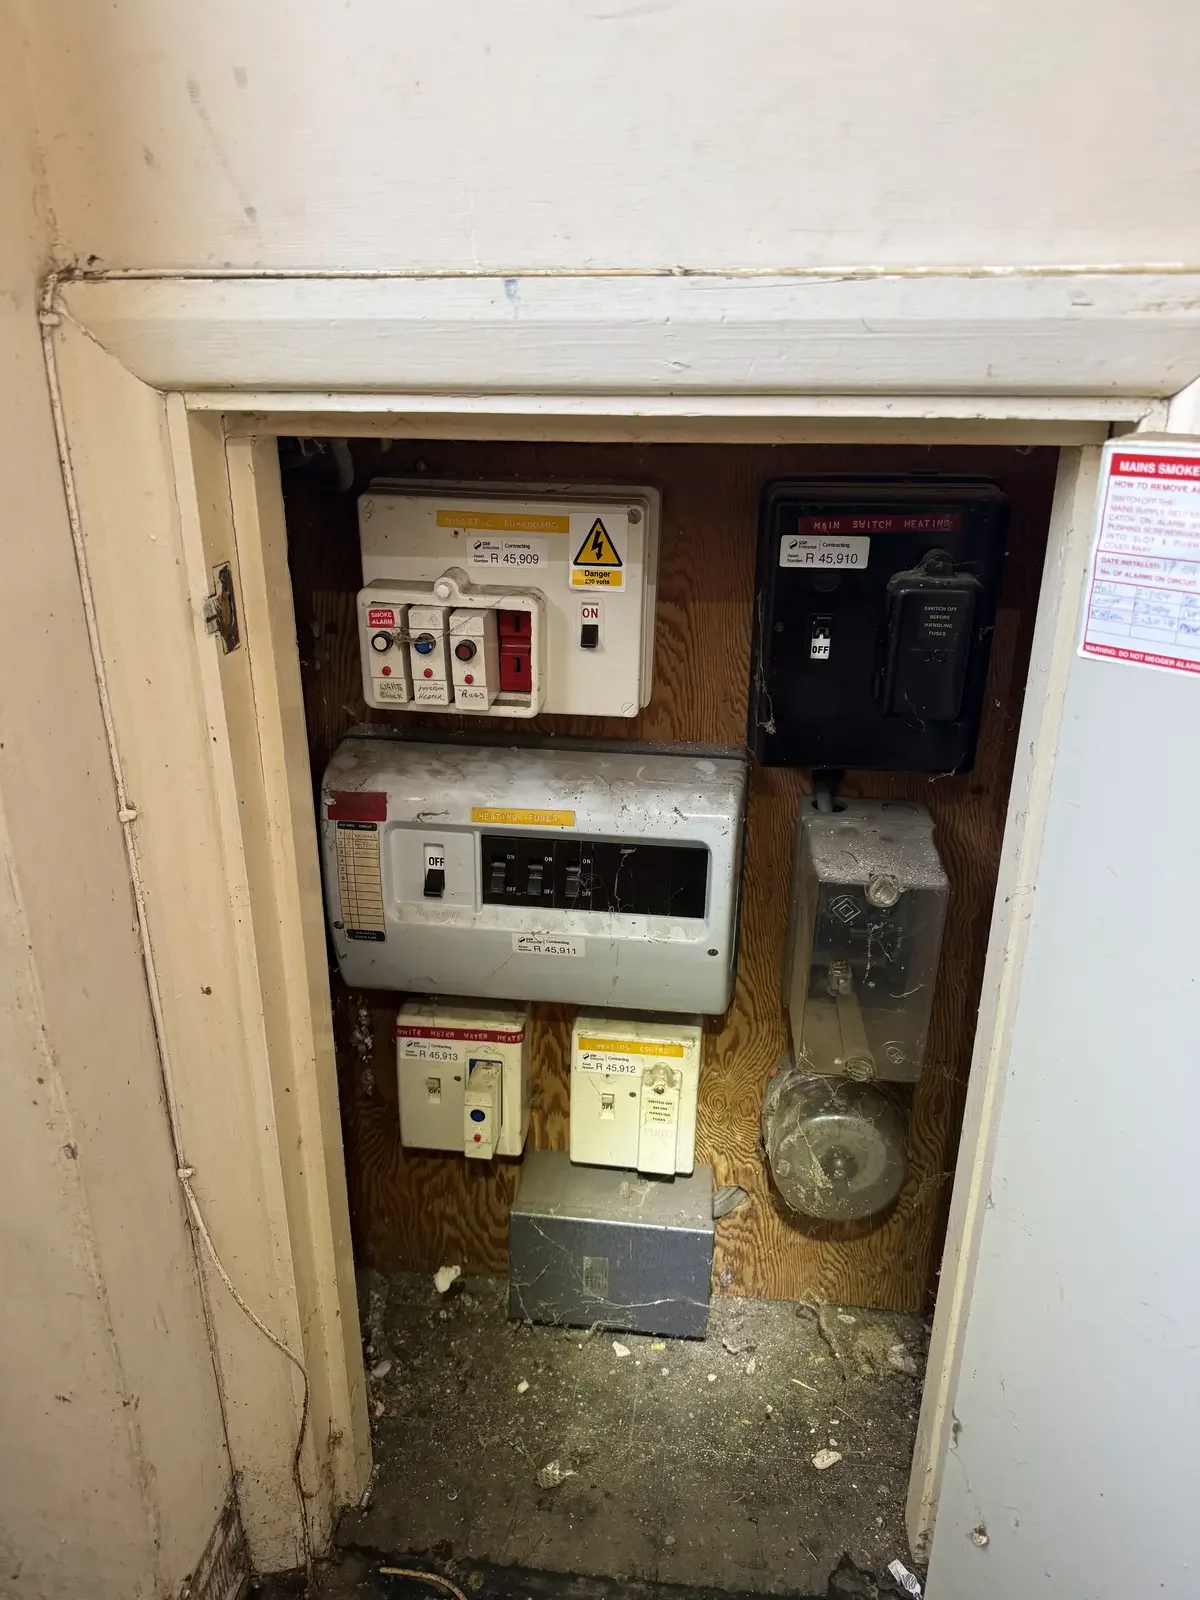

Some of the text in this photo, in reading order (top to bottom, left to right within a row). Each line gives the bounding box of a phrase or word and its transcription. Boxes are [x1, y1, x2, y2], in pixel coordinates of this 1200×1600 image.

[1120, 460, 1156, 474] MAINS
[1114, 480, 1134, 489] HOW
[1137, 482, 1148, 490] TO
[1150, 484, 1188, 493] REMOVE
[814, 519, 951, 530] MAIN SWITCH HEATING
[490, 554, 539, 566] R 45,909
[806, 552, 858, 565] R 45,910
[584, 570, 611, 578] Danger
[1124, 572, 1152, 580] ALARMS
[582, 608, 598, 618] ON
[812, 646, 829, 654] OFF
[1085, 645, 1118, 656] WARNING:
[1118, 650, 1129, 658] DO
[1129, 652, 1144, 661] NOT
[478, 812, 518, 821] HEATING
[428, 856, 444, 866] OFF
[544, 946, 576, 955] 45,911
[420, 1050, 458, 1061] R 45,913
[606, 1064, 636, 1073] 45,912
